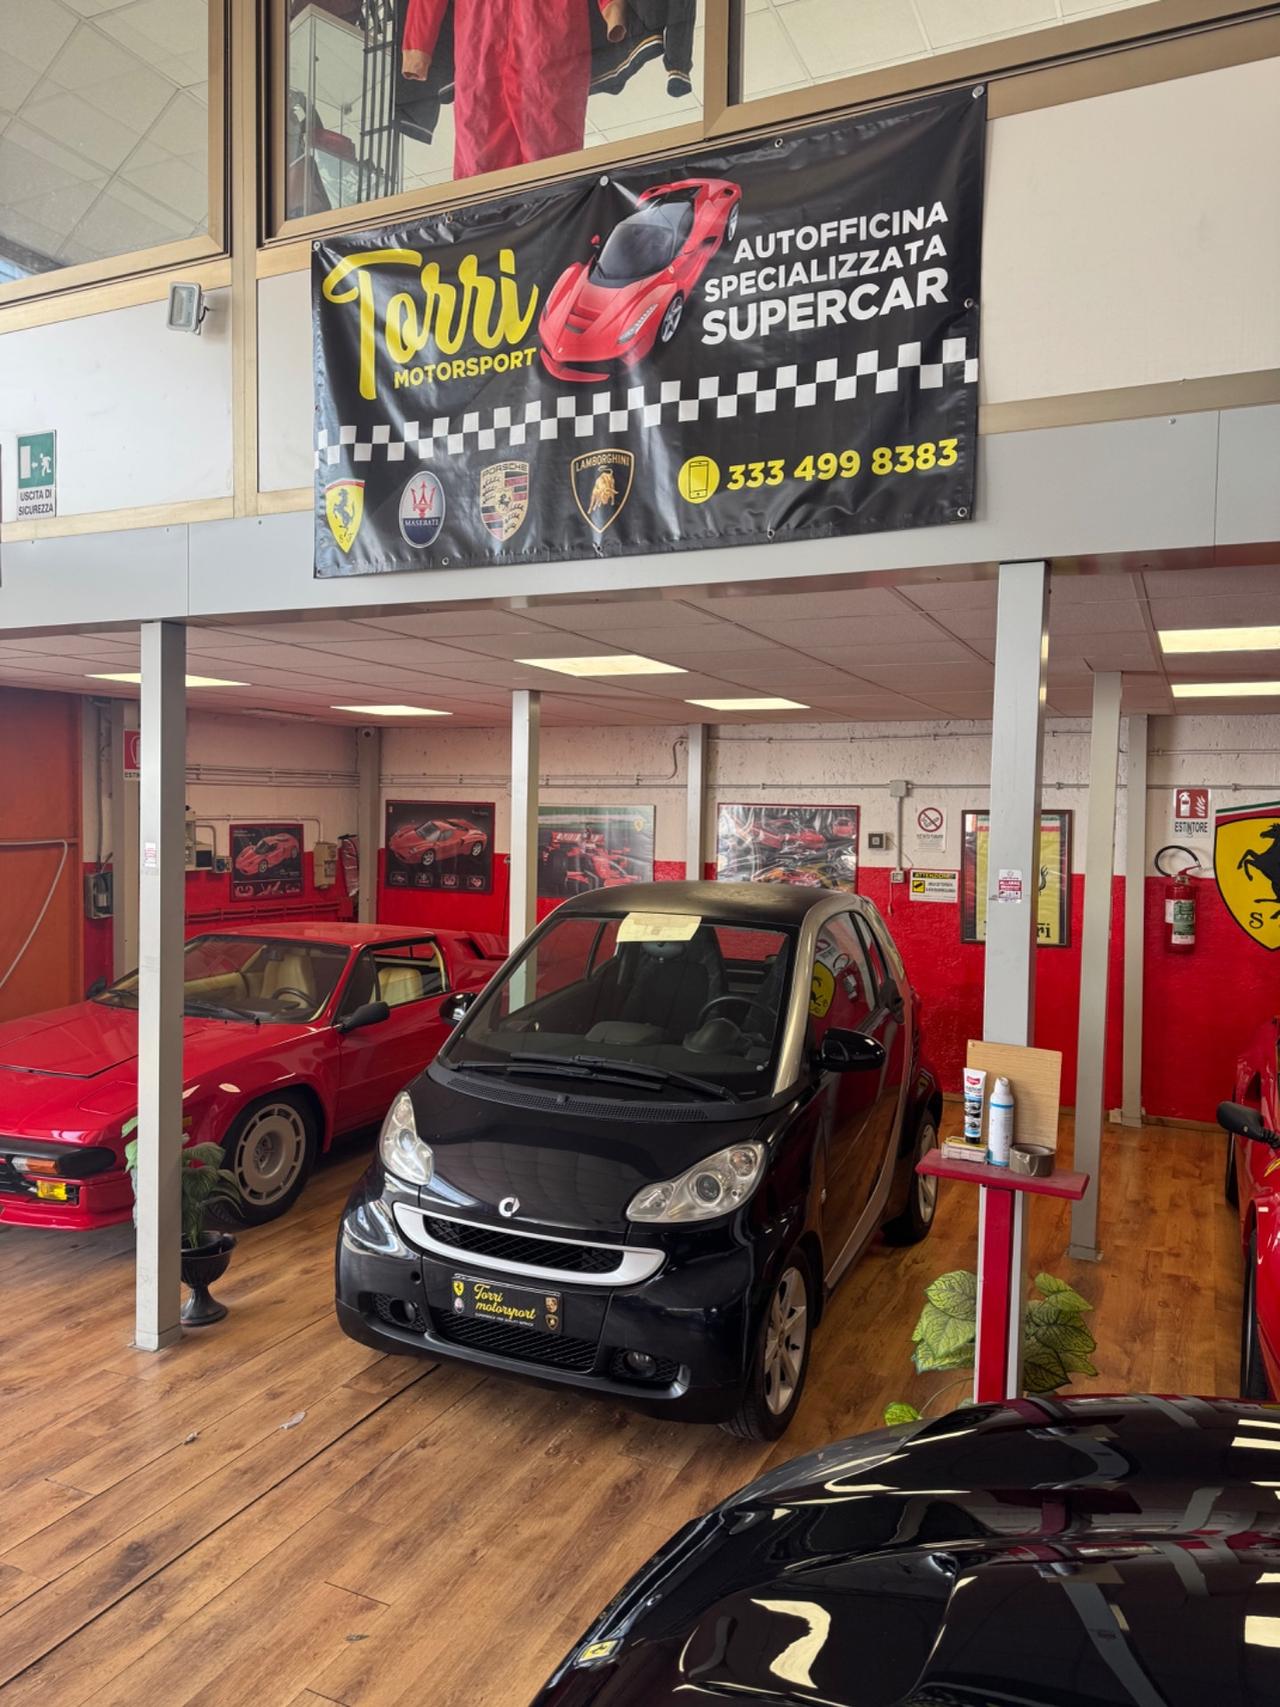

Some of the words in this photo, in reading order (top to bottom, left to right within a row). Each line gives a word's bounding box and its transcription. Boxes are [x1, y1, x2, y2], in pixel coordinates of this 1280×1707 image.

[733, 200, 949, 264] AUTOFFICINA
[703, 234, 947, 303] SPECIALIZZATA
[700, 266, 949, 346] SUPERCAR
[322, 248, 539, 400] Torri
[393, 347, 536, 389] MOTORSPORT
[482, 462, 528, 478] PORSCHE
[575, 453, 630, 472] LAMBORGHINI
[727, 459, 785, 491] 333
[793, 449, 861, 482] 499
[871, 438, 959, 476] 8383
[20, 490, 44, 502] USCITA
[45, 489, 52, 499] DI
[18, 503, 54, 516] SICUREZZA
[404, 519, 439, 527] MASERATI
[1174, 821, 1208, 833] ESTINTORE
[474, 1283, 504, 1302] Torri
[475, 1302, 537, 1320] motorsport
